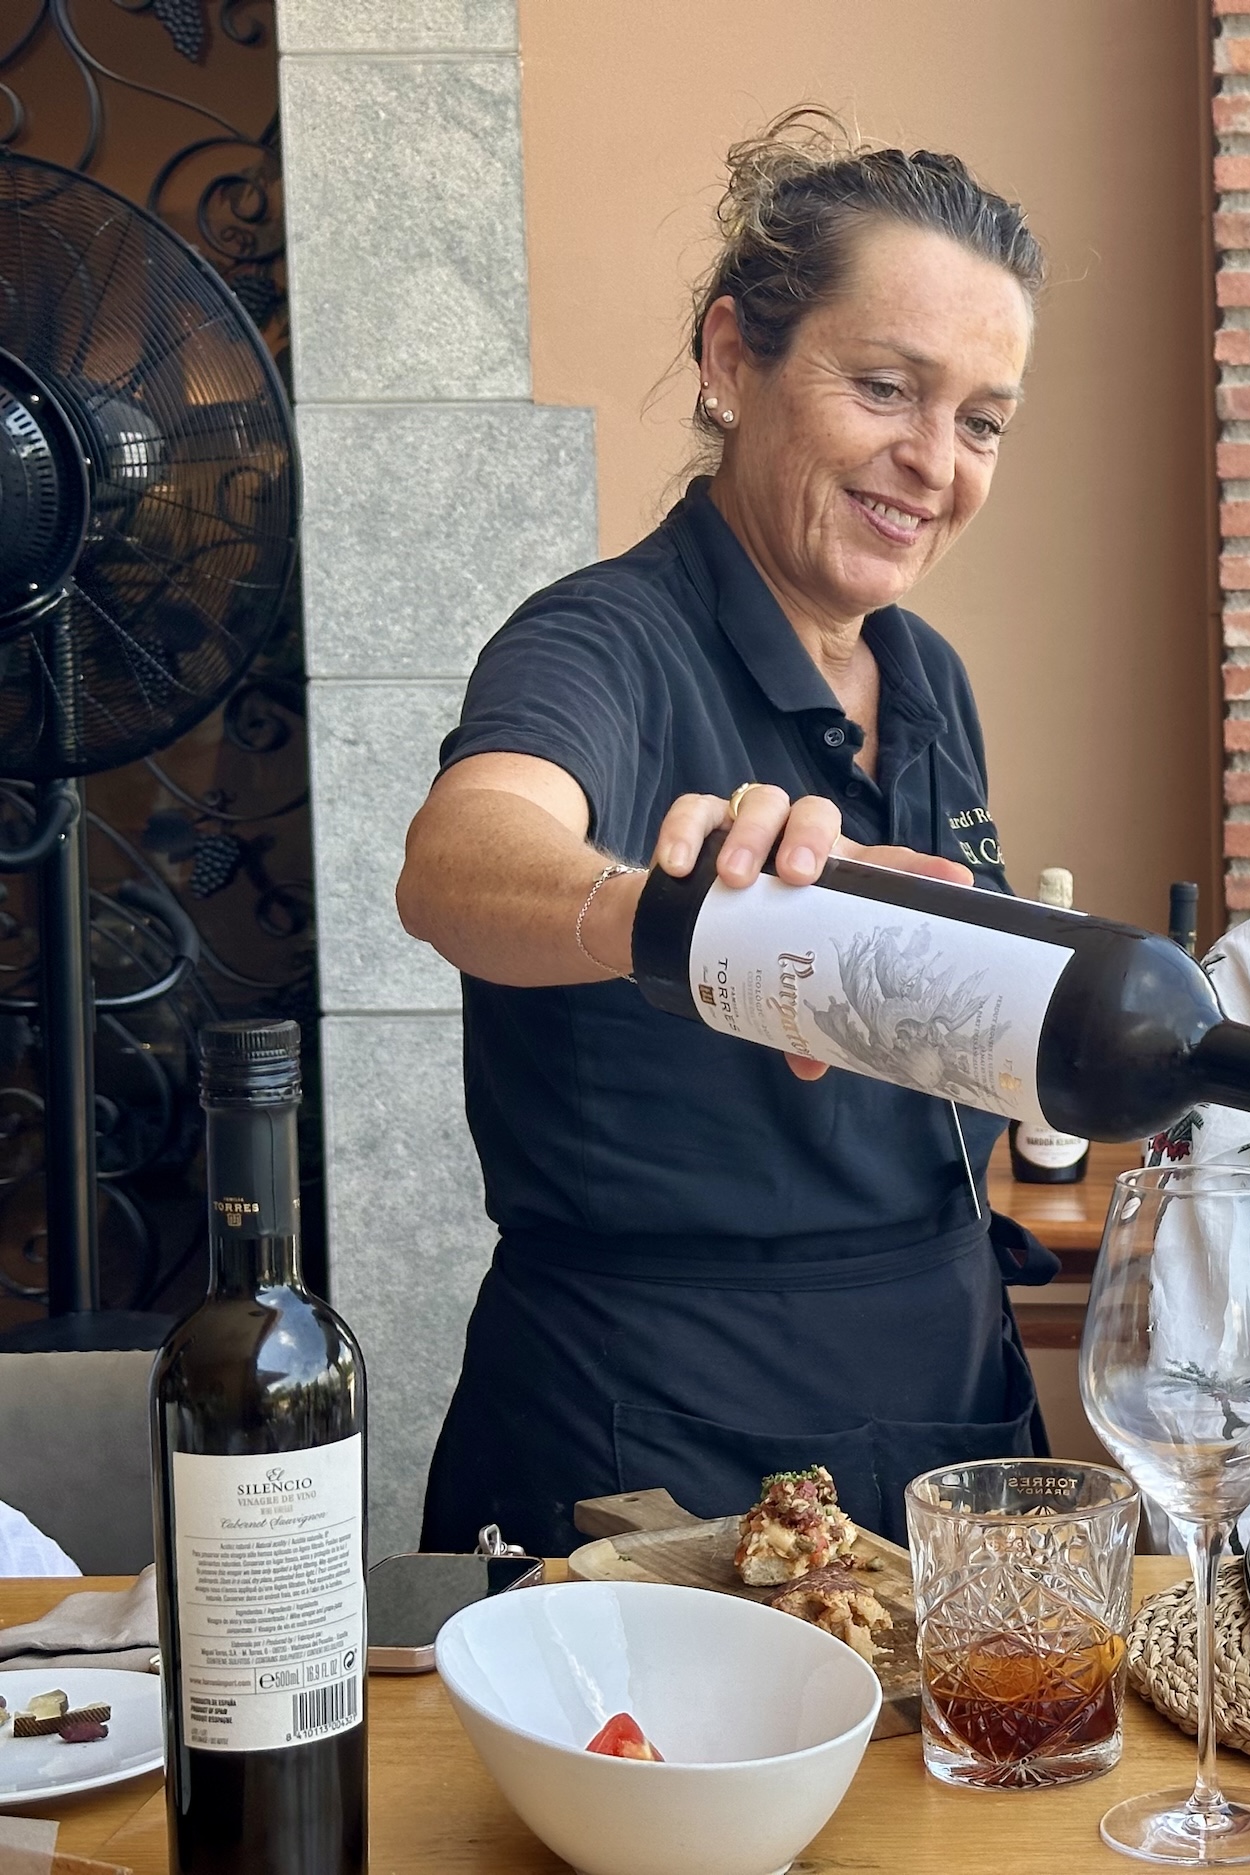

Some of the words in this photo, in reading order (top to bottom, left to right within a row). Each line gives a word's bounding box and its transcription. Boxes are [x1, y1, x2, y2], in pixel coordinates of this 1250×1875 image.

[717, 957, 741, 1032] TORRES
[213, 1201, 260, 1213] TORRES
[266, 1467, 285, 1481] El
[237, 1477, 312, 1496] SILENCIO
[238, 1496, 280, 1507] VINAGRE
[281, 1494, 295, 1503] DE
[296, 1490, 317, 1501] VINO
[220, 1517, 267, 1529] Cabernet
[269, 1511, 328, 1530] Sauvignon
[306, 1663, 320, 1682] 16.9
